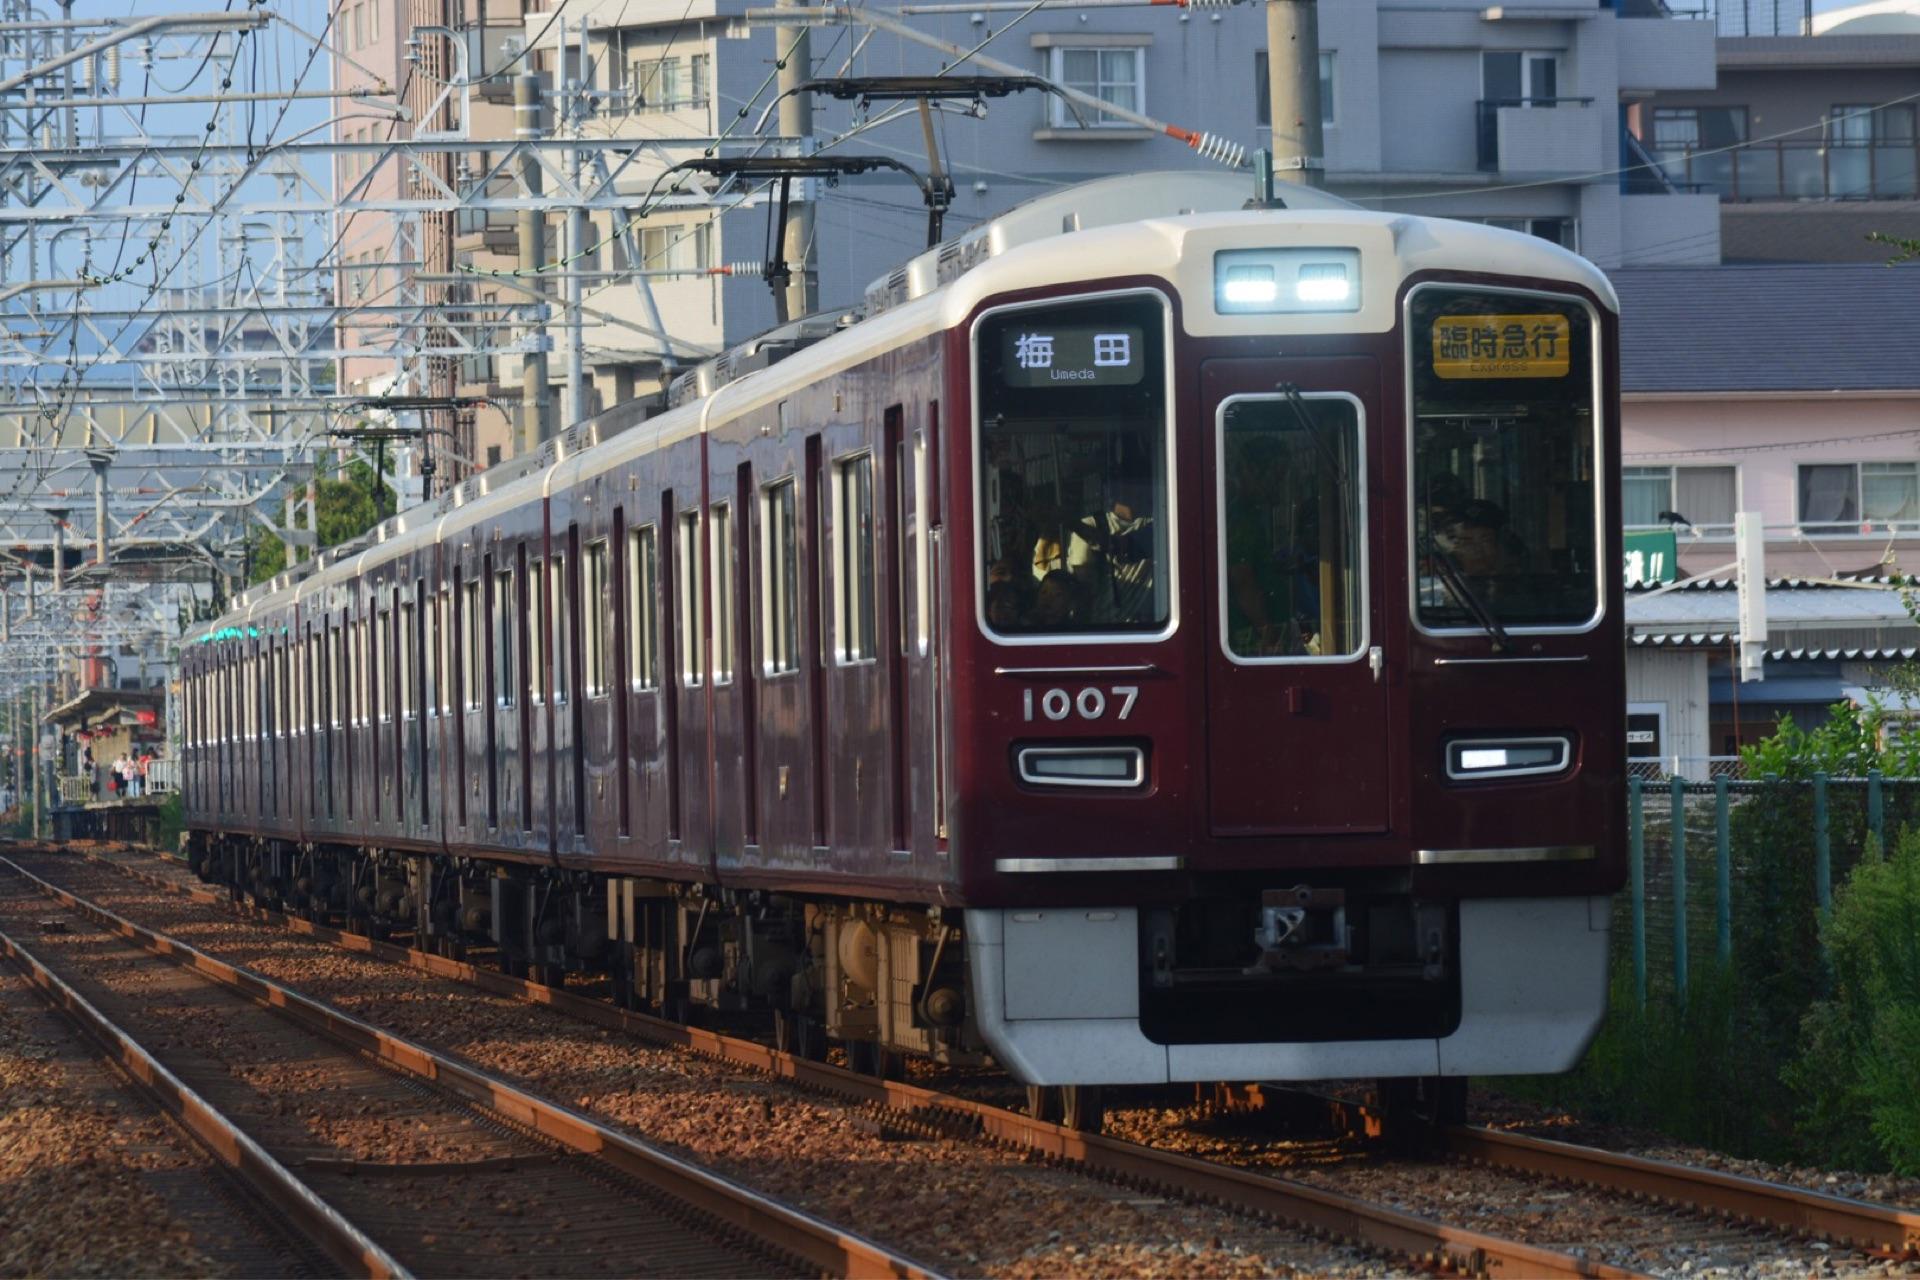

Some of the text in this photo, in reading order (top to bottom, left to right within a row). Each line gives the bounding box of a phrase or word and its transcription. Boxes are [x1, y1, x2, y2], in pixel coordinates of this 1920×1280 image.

[1014, 333, 1130, 368] 梅田
[1440, 324, 1559, 359] 臨時急行
[1050, 368, 1096, 380] Umeda
[1470, 362, 1529, 374] Express
[1023, 686, 1139, 721] 1007
